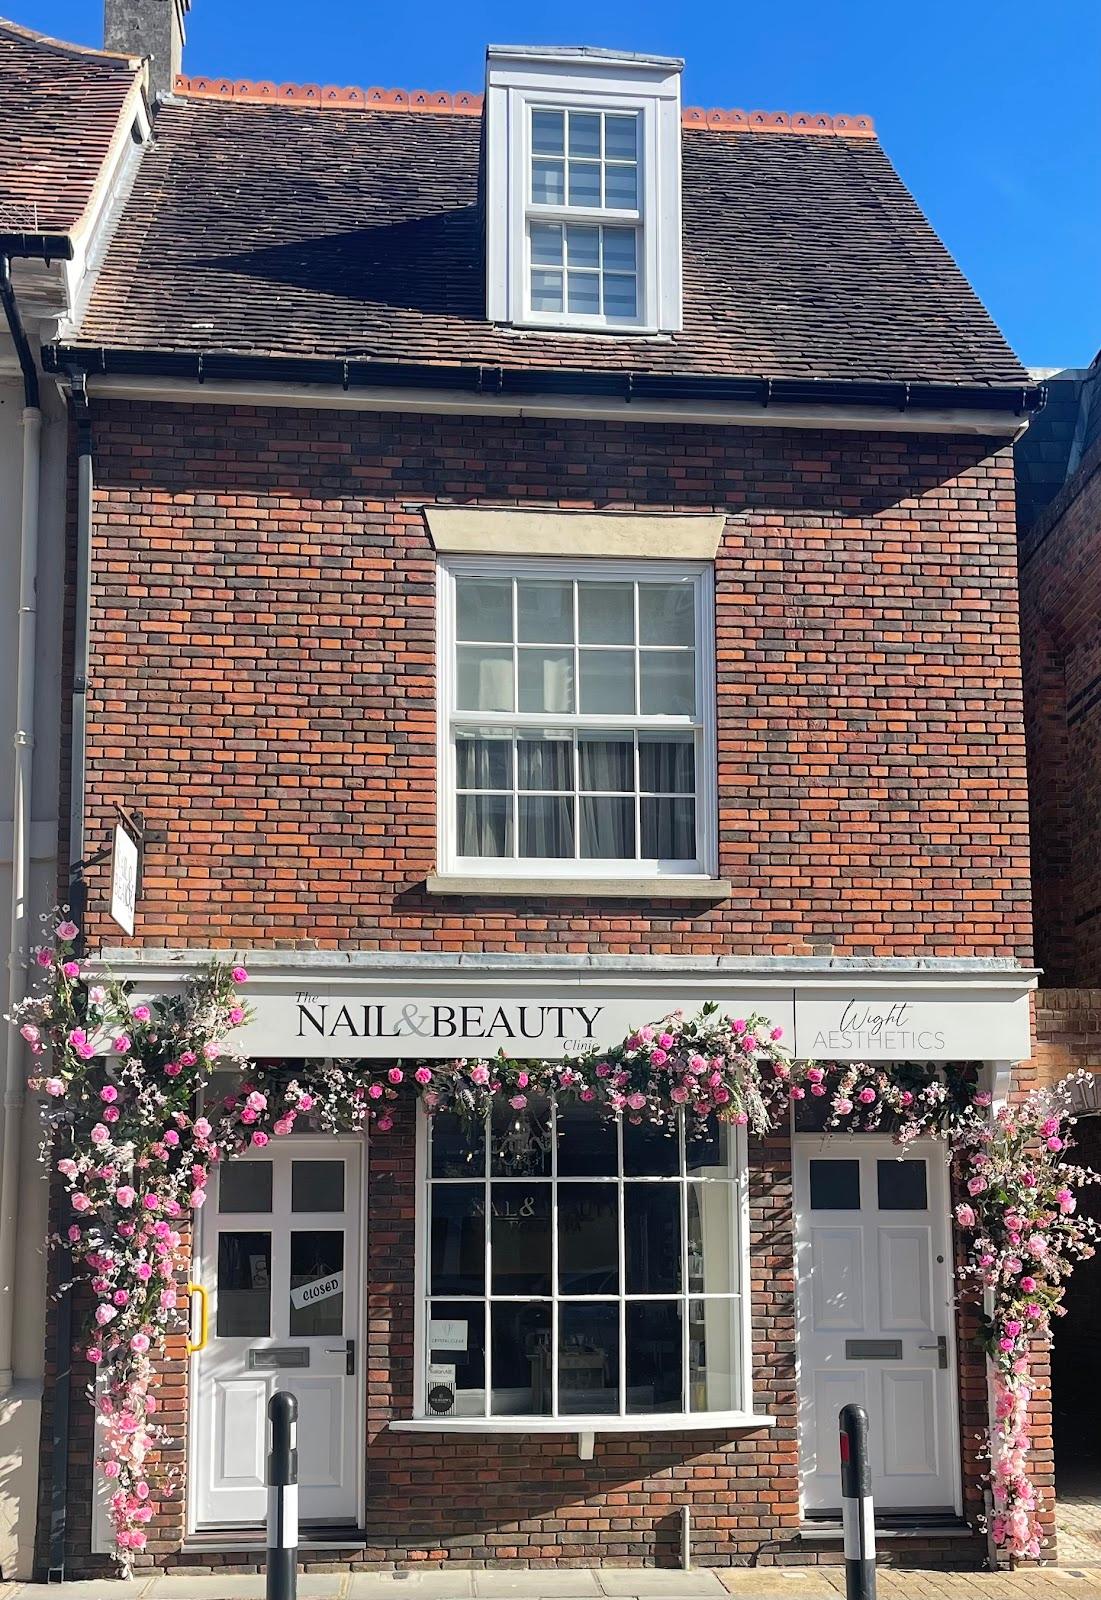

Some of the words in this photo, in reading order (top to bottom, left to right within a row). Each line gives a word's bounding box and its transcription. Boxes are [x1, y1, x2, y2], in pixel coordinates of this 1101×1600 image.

[295, 991, 319, 1003] The
[839, 998, 914, 1035] Wight
[812, 1031, 945, 1050] AESTHETICS
